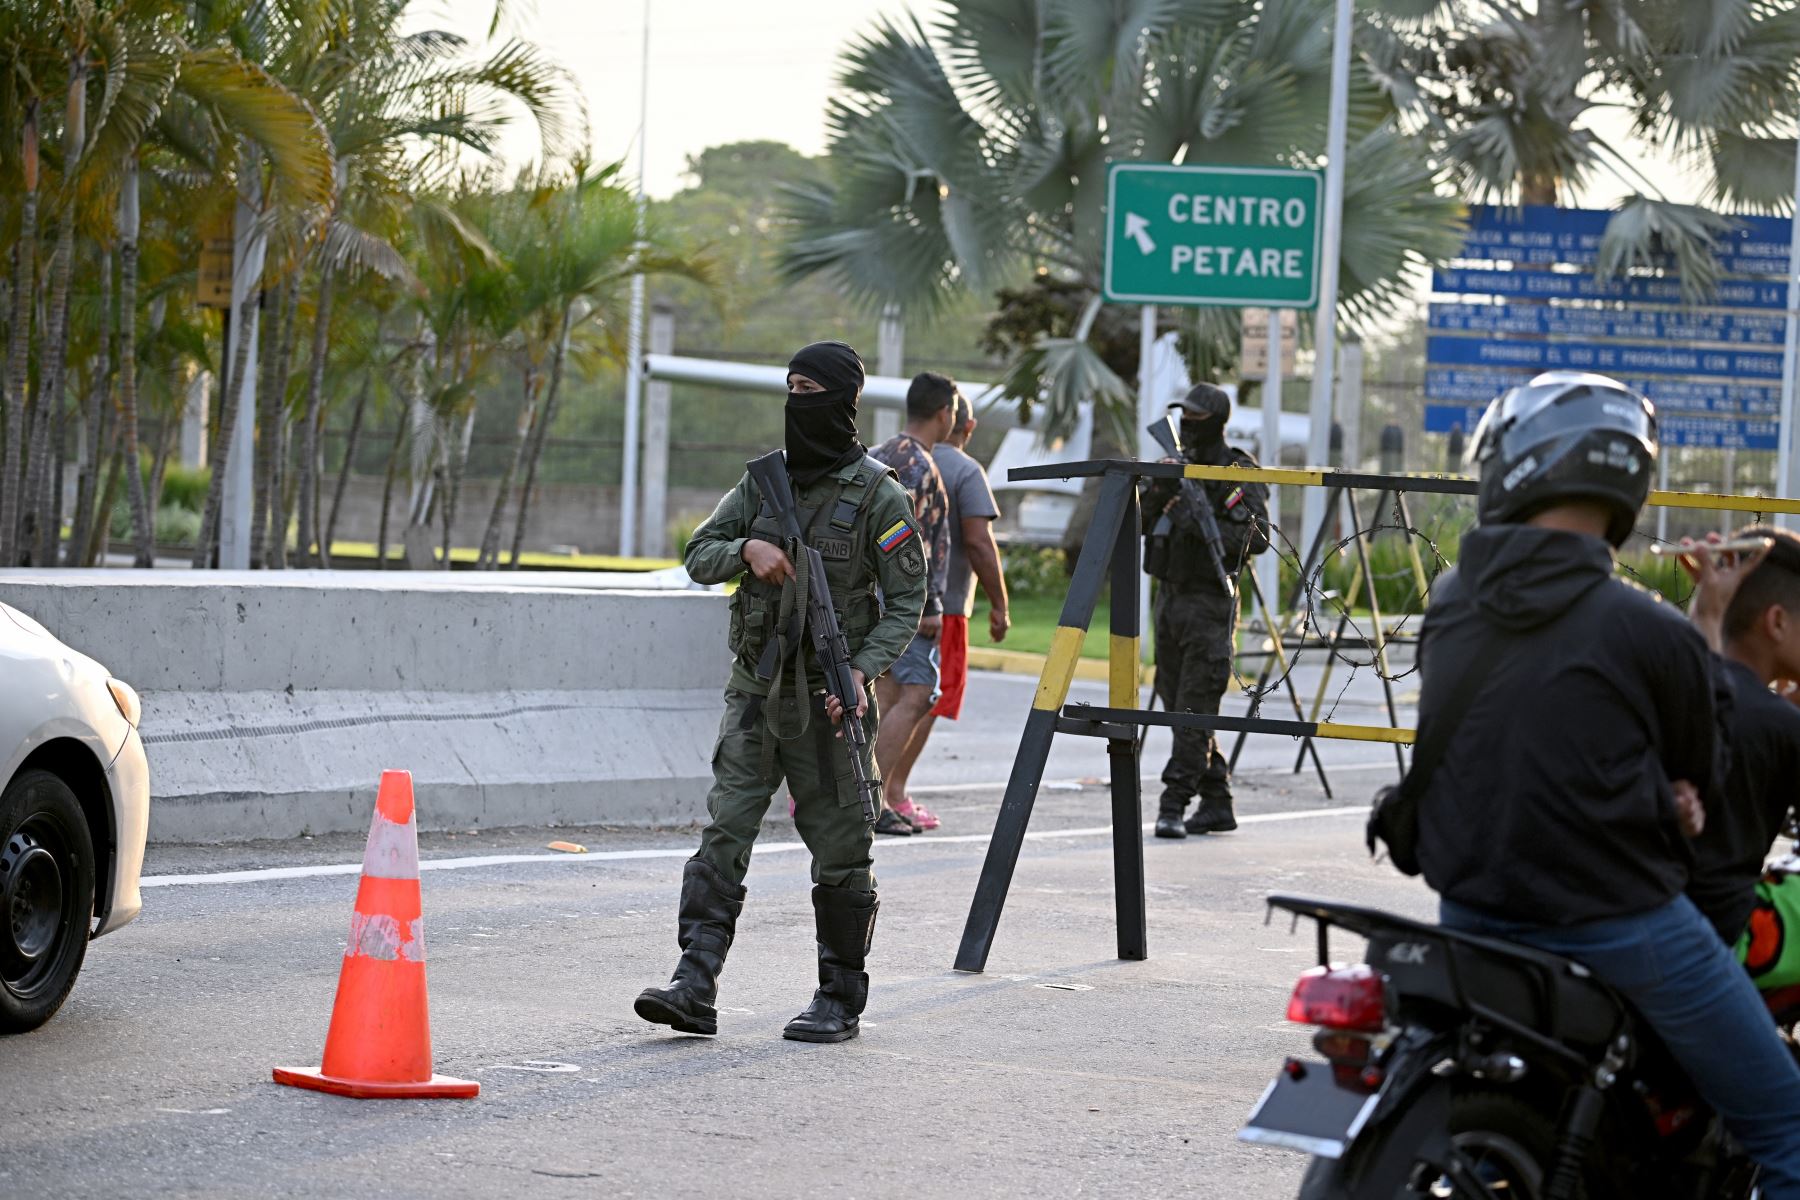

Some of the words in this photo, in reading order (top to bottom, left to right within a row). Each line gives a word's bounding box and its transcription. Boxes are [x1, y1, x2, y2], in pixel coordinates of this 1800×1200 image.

[1168, 193, 1306, 227] CENTRO
[1171, 245, 1303, 278] PETARE
[816, 541, 848, 556] FANB
